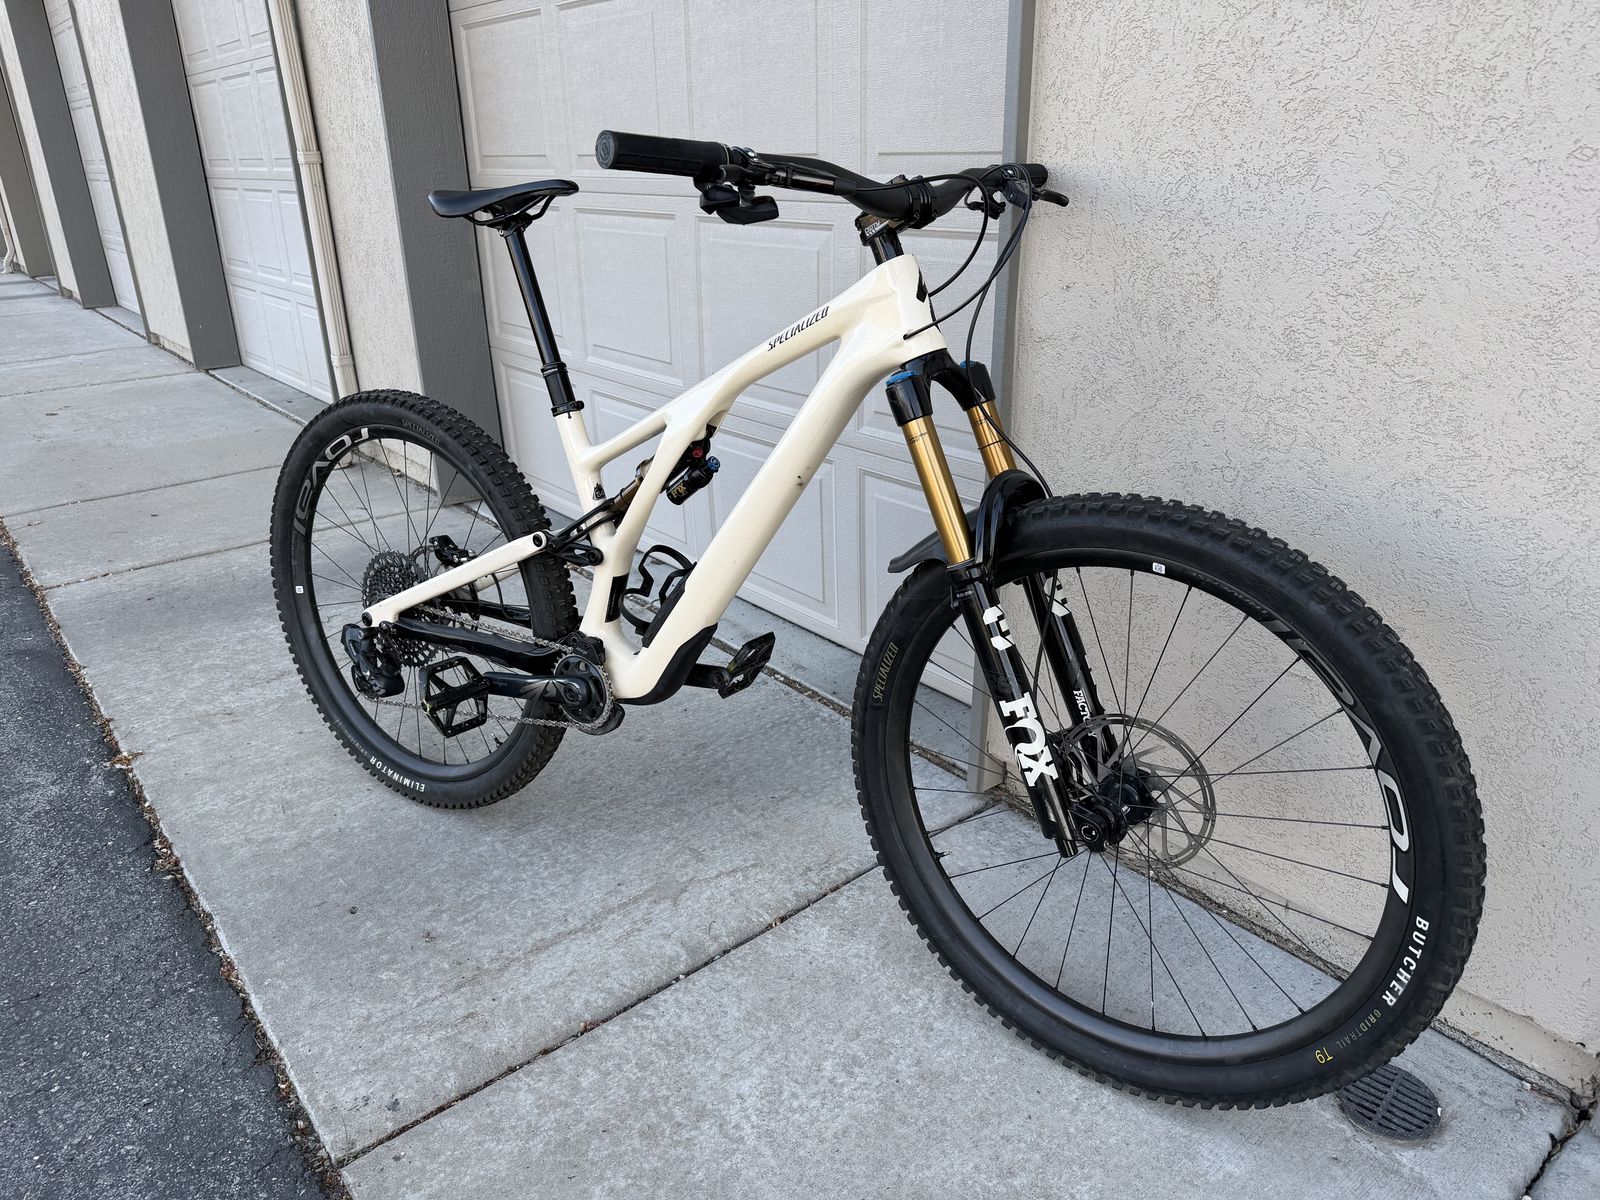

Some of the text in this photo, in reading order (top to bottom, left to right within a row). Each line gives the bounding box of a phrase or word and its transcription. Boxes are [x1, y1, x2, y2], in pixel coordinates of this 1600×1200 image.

[768, 306, 829, 351] SPECIALIZED
[872, 641, 899, 702] SPECIALIZED
[999, 691, 1059, 787] FOX
[370, 755, 426, 792] ELIMINATOR
[1382, 915, 1430, 1008] BUTCHER
[1315, 1047, 1333, 1064] T9
